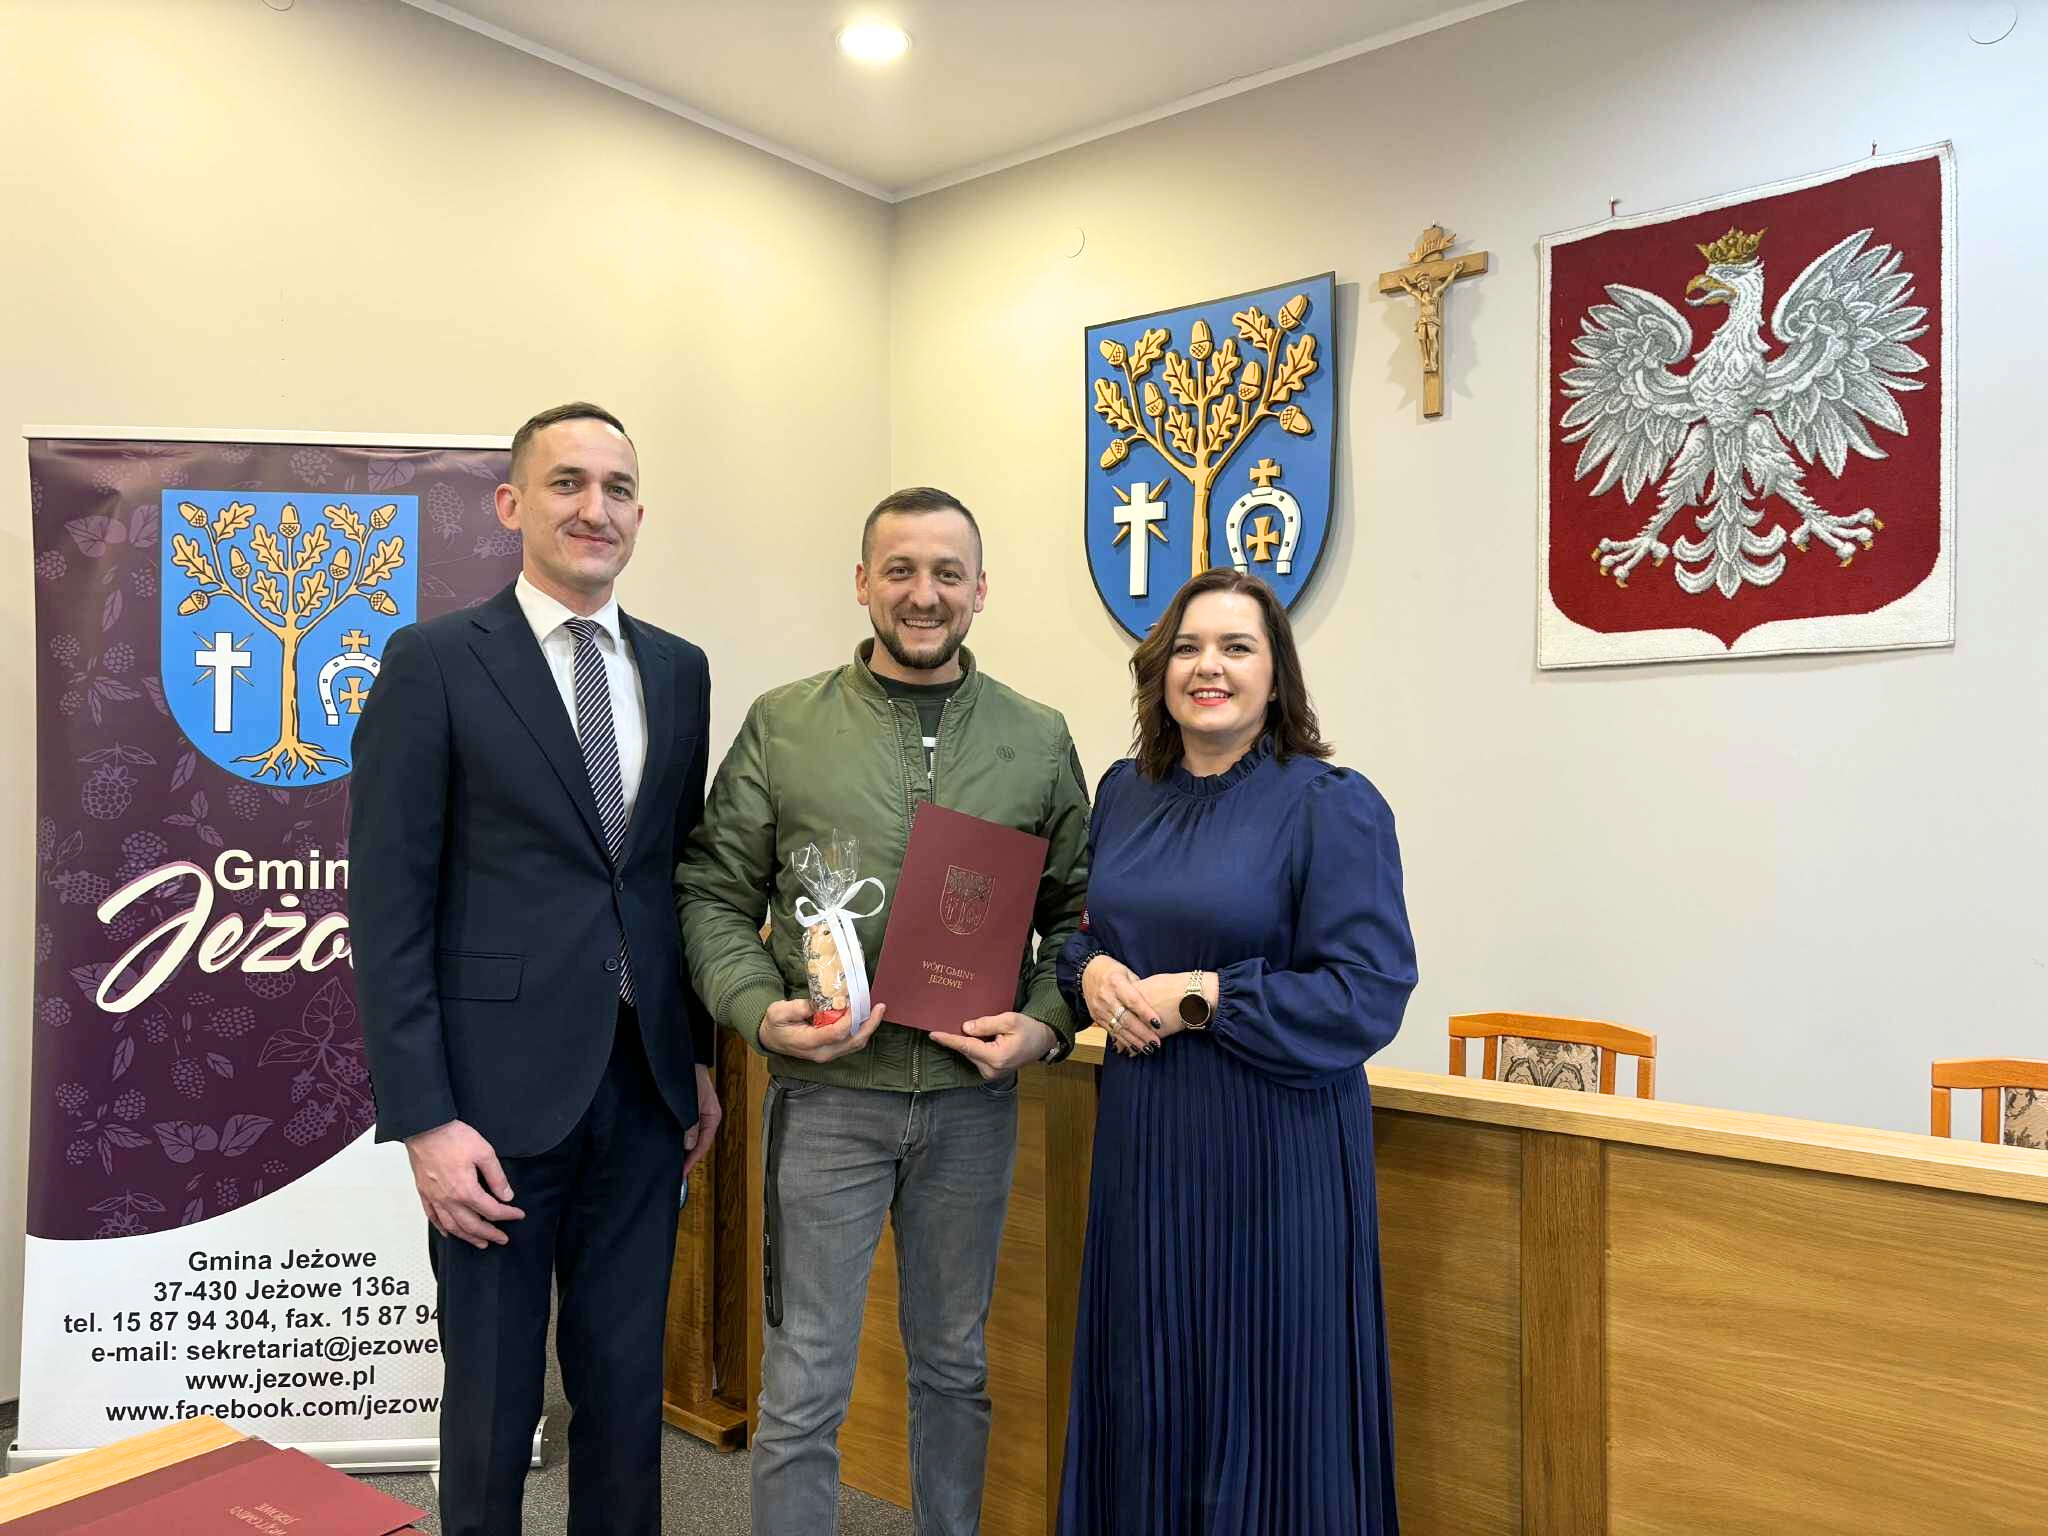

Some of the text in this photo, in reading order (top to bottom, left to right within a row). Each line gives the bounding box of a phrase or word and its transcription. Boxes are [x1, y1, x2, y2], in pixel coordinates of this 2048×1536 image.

[214, 849, 349, 890] Gmin
[96, 861, 353, 1013] Jeżo
[188, 1248, 377, 1272] Gmina Jeżowe
[153, 1276, 410, 1302] 37-430 Jeżowe 136a
[64, 1312, 103, 1334] tel.
[113, 1311, 141, 1332] 15
[149, 1311, 179, 1332] 87
[187, 1310, 217, 1331] 94
[225, 1309, 276, 1333] 304,
[285, 1307, 331, 1329] fax.
[341, 1306, 370, 1327] 15
[378, 1305, 407, 1326] 87
[91, 1336, 439, 1363] e-mail: sekretariat@jezowe
[185, 1364, 375, 1392] www.jezowe.pl
[105, 1394, 441, 1422] www.facebook.com/jezow
